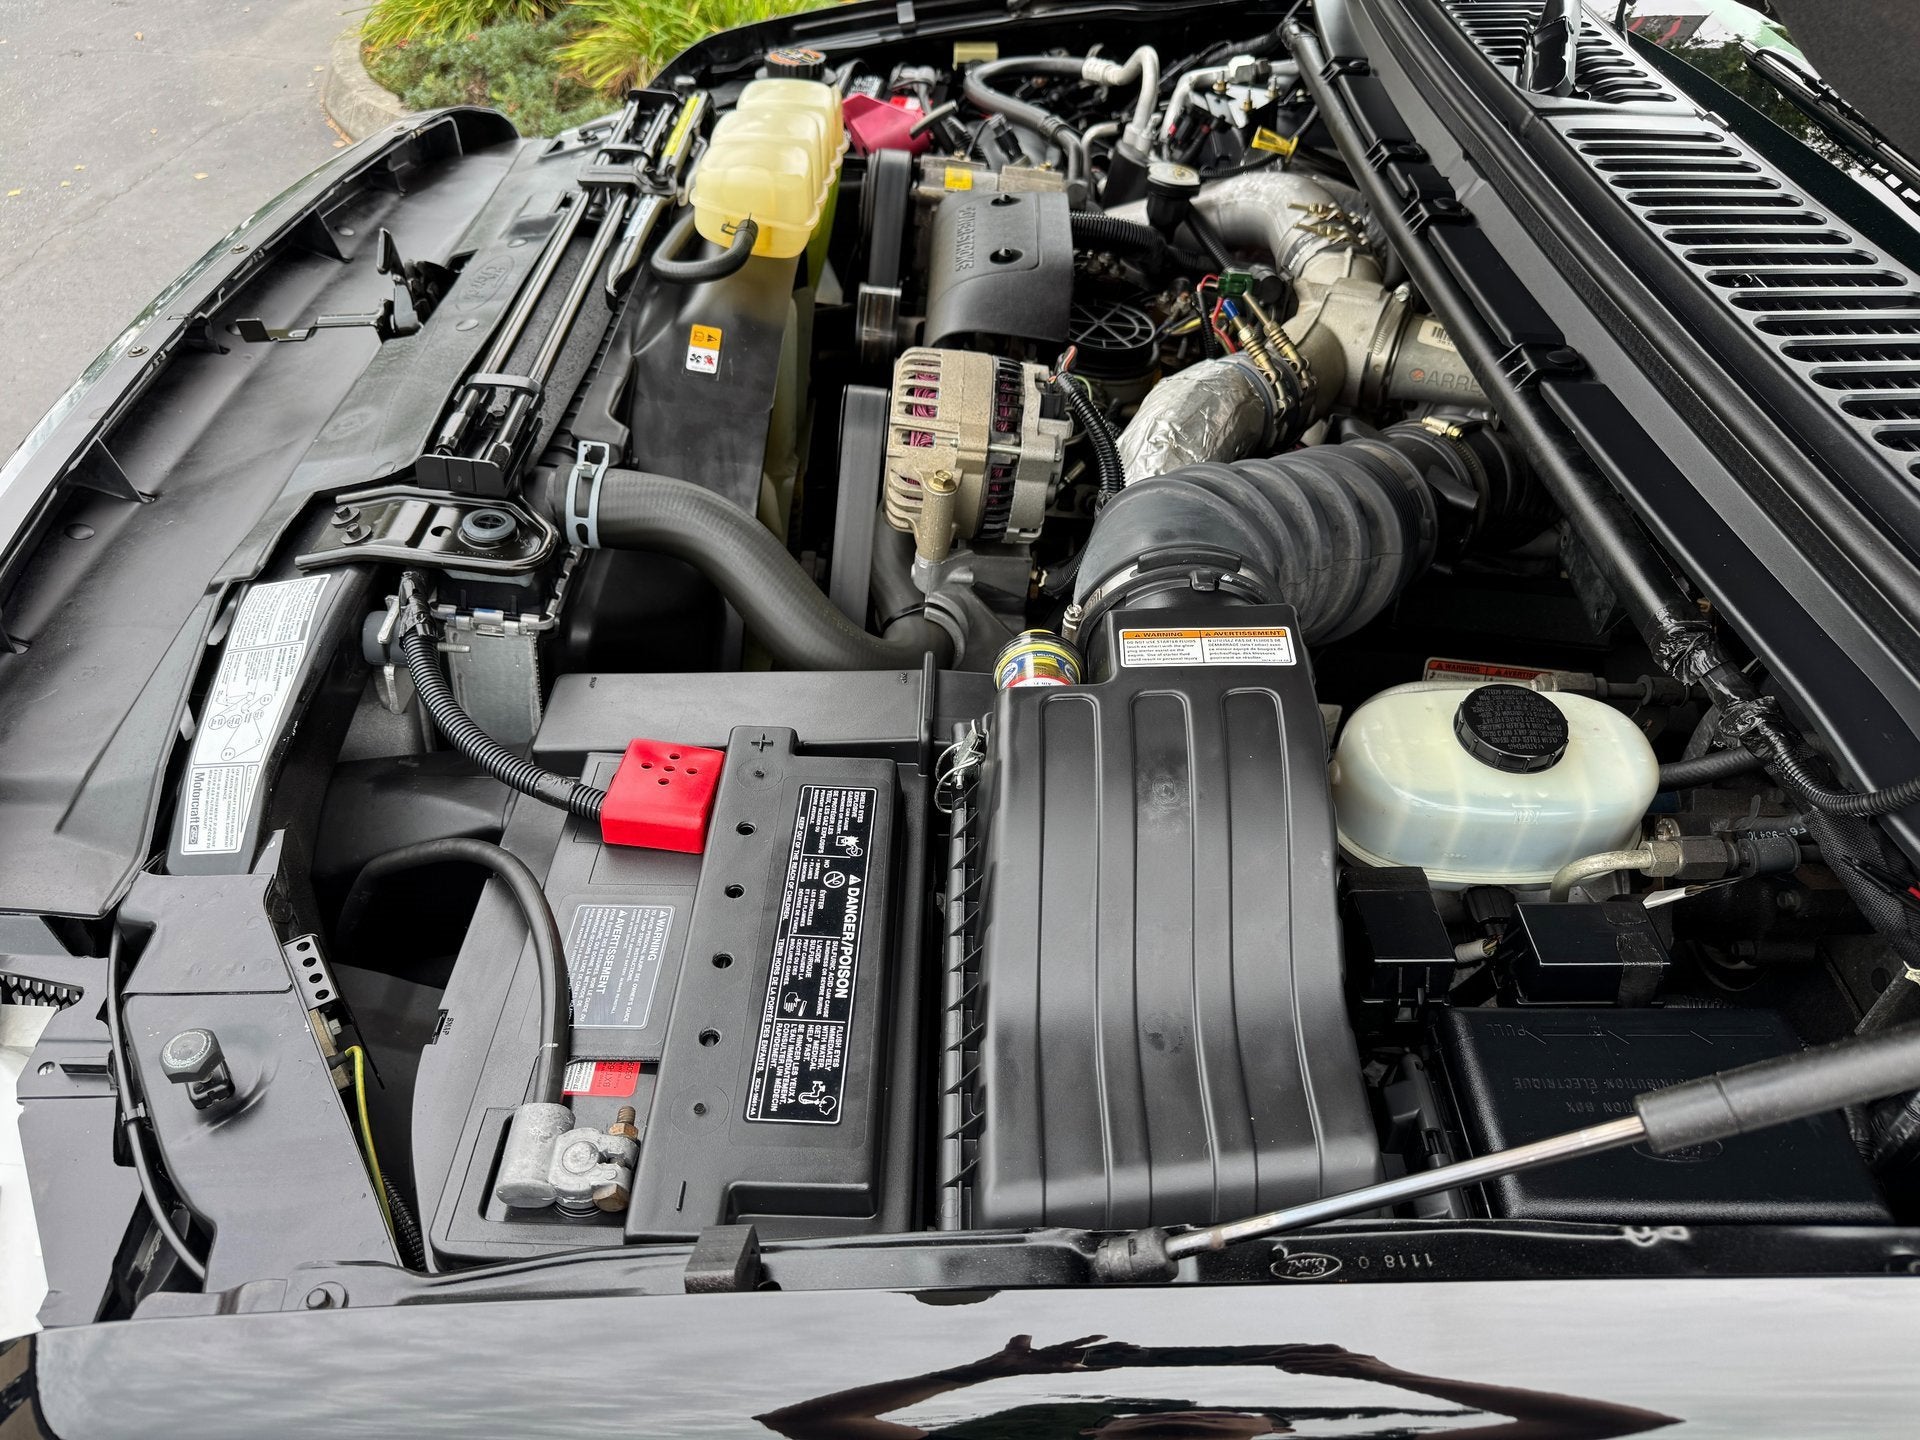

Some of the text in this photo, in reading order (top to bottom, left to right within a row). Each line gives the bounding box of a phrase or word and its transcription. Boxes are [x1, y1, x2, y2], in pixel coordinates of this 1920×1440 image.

[187, 771, 206, 824] Motorcraft
[845, 790, 853, 807] GASES
[850, 790, 859, 818] EXPLOSIVE
[856, 790, 866, 823] SHIELD EYES
[797, 816, 805, 829] KEEP
[795, 830, 803, 840] OUT
[792, 849, 800, 860] THE
[823, 859, 830, 868] NO
[788, 861, 798, 881] REACH
[787, 881, 794, 889] OF
[781, 890, 793, 920] CHILDREN.
[646, 918, 666, 961] WARNING
[801, 938, 809, 951] PEUT
[813, 939, 823, 963] L'ACIDE
[833, 887, 859, 998] DANGER/POISON
[594, 917, 625, 994] AVERTISSEMENT
[793, 956, 799, 964] OU
[804, 938, 816, 977] SULFURIQUE
[828, 940, 838, 970] SULFURIC
[797, 972, 804, 980] LA
[821, 967, 827, 975] OR
[826, 971, 834, 988] ACID
[818, 976, 826, 995] SEVERE
[756, 937, 785, 1073] TENIR HORS DE LA PORTÉE DES ENFANTS.
[822, 999, 830, 1017] CAUSE
[788, 1023, 797, 1042] L'EAU
[796, 1023, 804, 1033] SE
[769, 1022, 782, 1069] RAPIDEMENT.
[793, 1035, 803, 1060] RINCER
[802, 1024, 814, 1062] HELP FAST.
[808, 1024, 821, 1071] GET MEDICAL
[816, 1024, 828, 1070] WITH WATER.
[823, 1025, 836, 1071] IMMEDIATELY
[831, 1025, 843, 1067] FLUSH EYES
[770, 1022, 790, 1111] CONSULTER UN MÉDECIN
[790, 1062, 799, 1075] LES
[787, 1077, 797, 1096] YEUX
